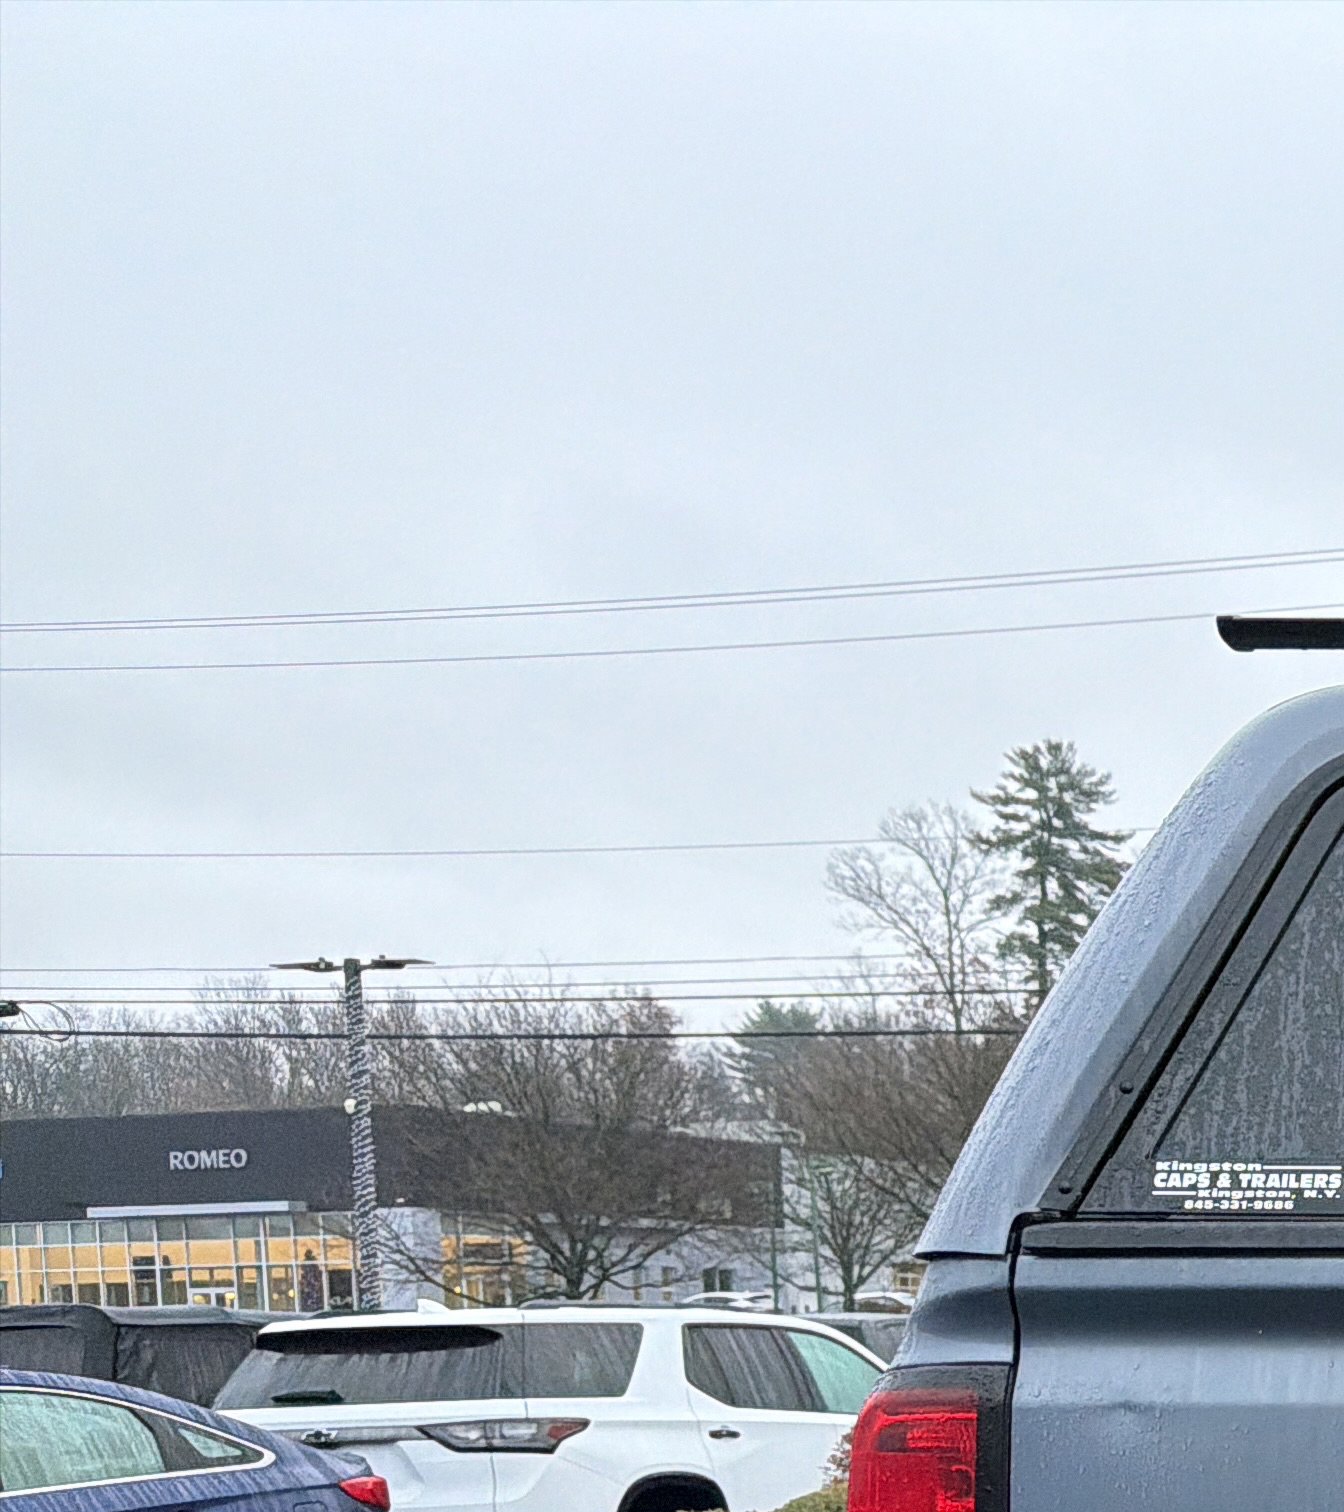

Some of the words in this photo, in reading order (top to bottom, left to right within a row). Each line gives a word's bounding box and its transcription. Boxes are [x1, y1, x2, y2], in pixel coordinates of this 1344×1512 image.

[168, 1148, 248, 1171] ROMEO
[1155, 1160, 1262, 1173] Kingston
[1153, 1173, 1211, 1188] CAPS
[1216, 1173, 1231, 1188] &
[1239, 1173, 1342, 1188] TRAILERS
[1197, 1189, 1297, 1200] Kingston,
[1303, 1189, 1341, 1199] N.Y.
